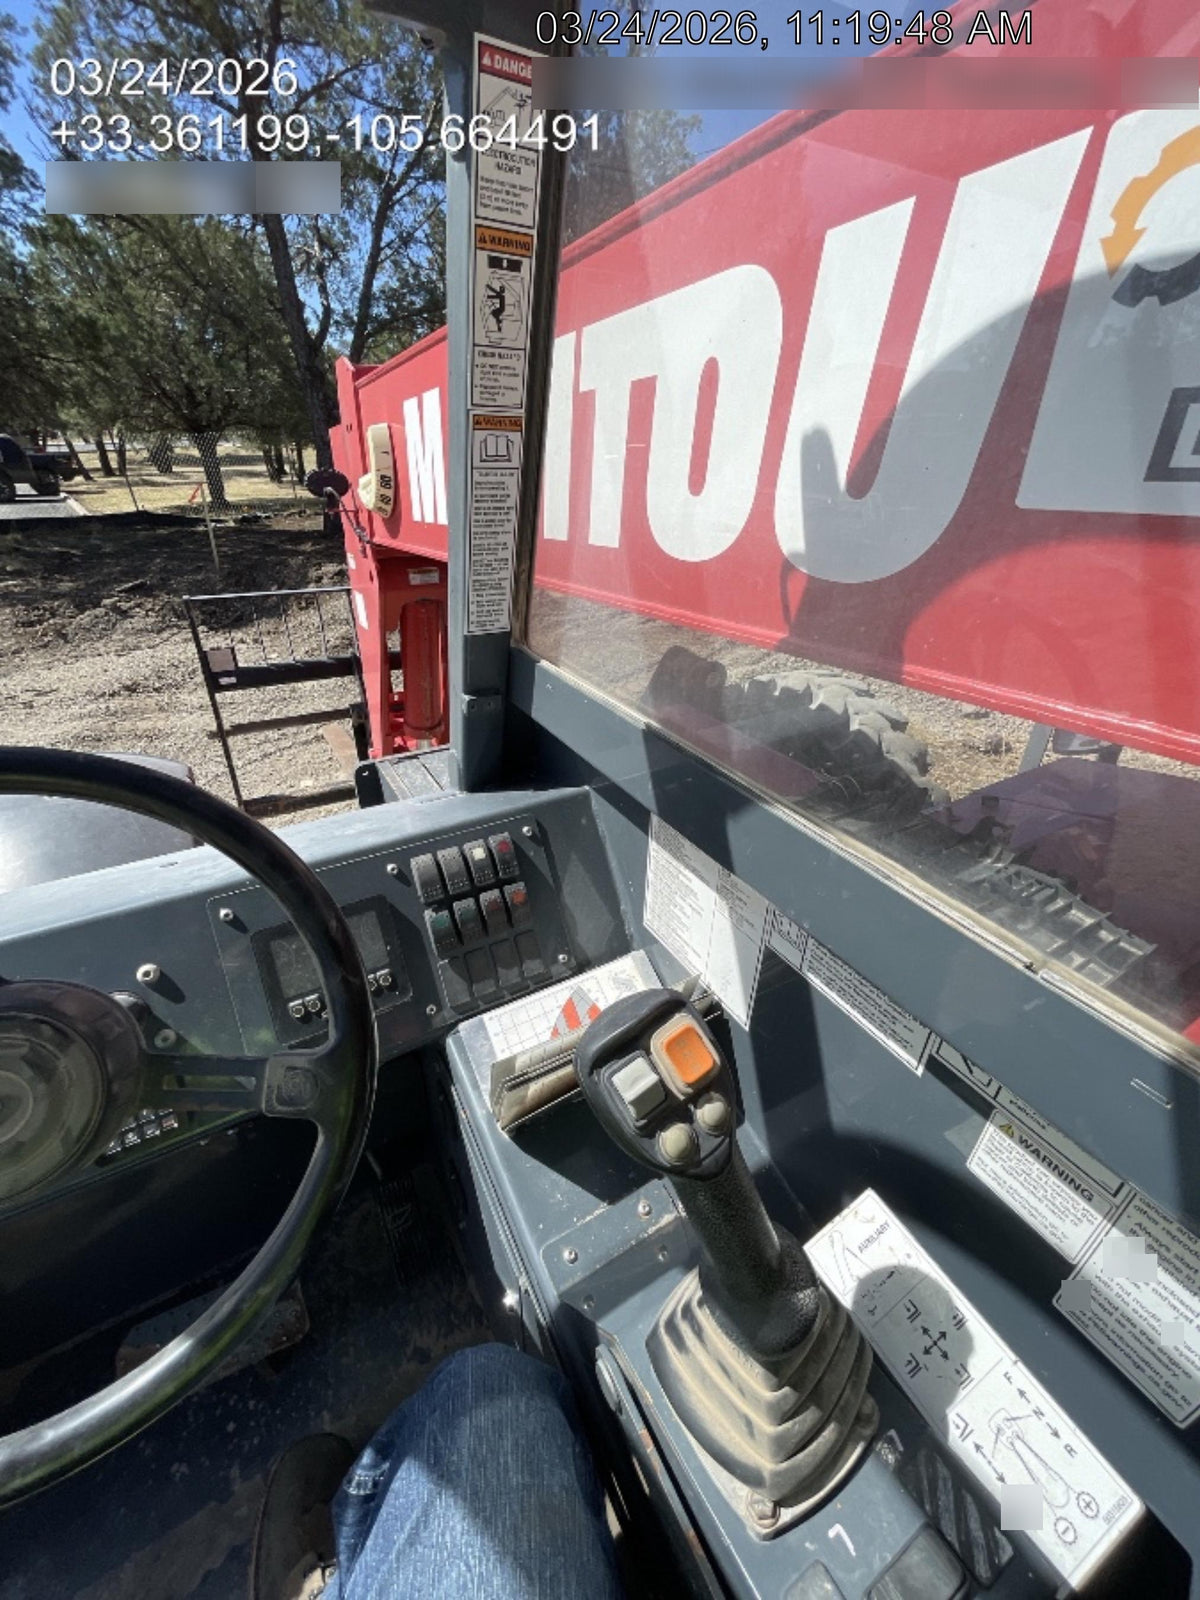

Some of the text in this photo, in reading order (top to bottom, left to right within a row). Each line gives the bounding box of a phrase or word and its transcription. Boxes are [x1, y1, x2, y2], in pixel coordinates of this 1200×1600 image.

[494, 55, 532, 79] DANGE
[1015, 1134, 1095, 1202] WARNING
[1132, 1202, 1160, 1226] other
[857, 1221, 892, 1254] AUXILIARY
[1133, 1219, 1173, 1253] Always
[1063, 1442, 1079, 1459] R
